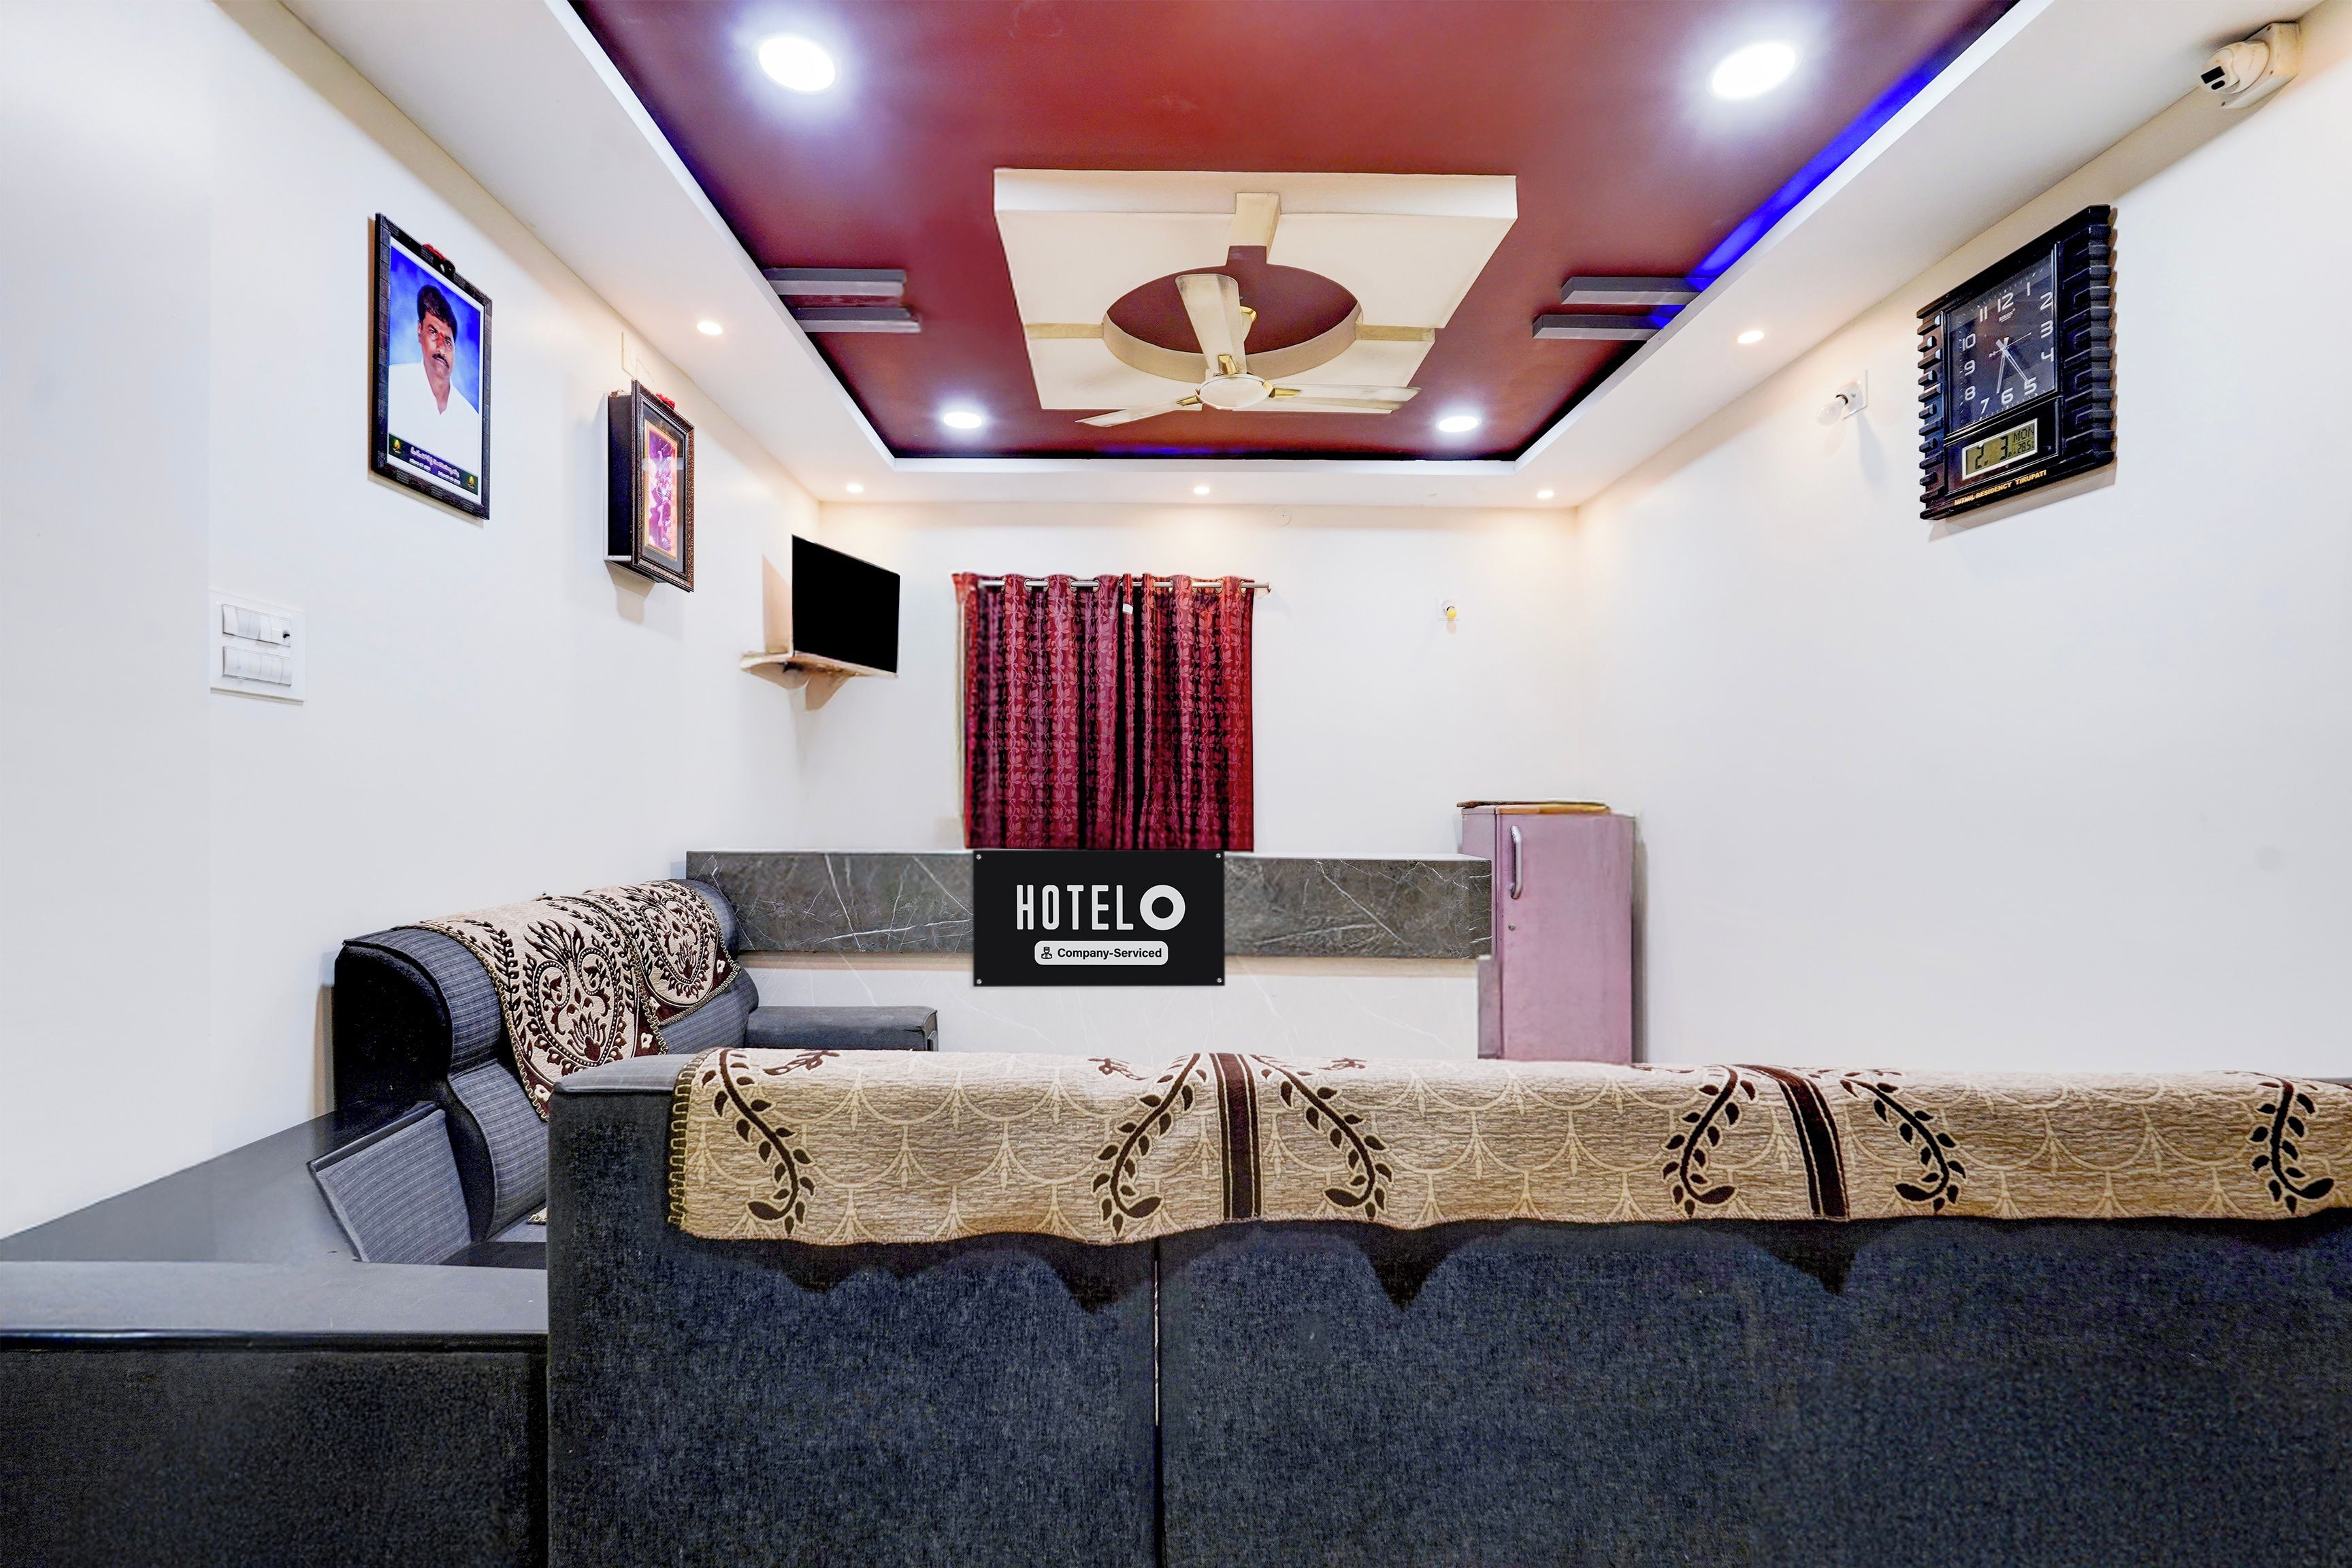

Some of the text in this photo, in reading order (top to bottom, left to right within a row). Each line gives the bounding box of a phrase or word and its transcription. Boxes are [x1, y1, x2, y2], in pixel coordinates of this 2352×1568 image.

[2027, 282, 2030, 297] 1
[1997, 292, 2014, 312] 12
[2040, 291, 2053, 310] 2
[1980, 306, 1987, 323] 11
[2040, 320, 2053, 338] 3
[1962, 333, 1976, 351] 10
[2041, 347, 2054, 362] 4
[1964, 359, 1975, 376] 9
[1965, 385, 1976, 401] 8
[2024, 376, 2037, 395] 5
[2002, 387, 2014, 404] 6
[1980, 397, 1990, 414] 7
[2014, 427, 2034, 443] MON
[1999, 435, 2008, 461] 3
[1976, 482, 2012, 499] RESIDENCY
[2014, 470, 2046, 485] TIRUPATI
[1016, 885, 1134, 930] HOTEL
[1057, 947, 1162, 960] Company-Serviced
